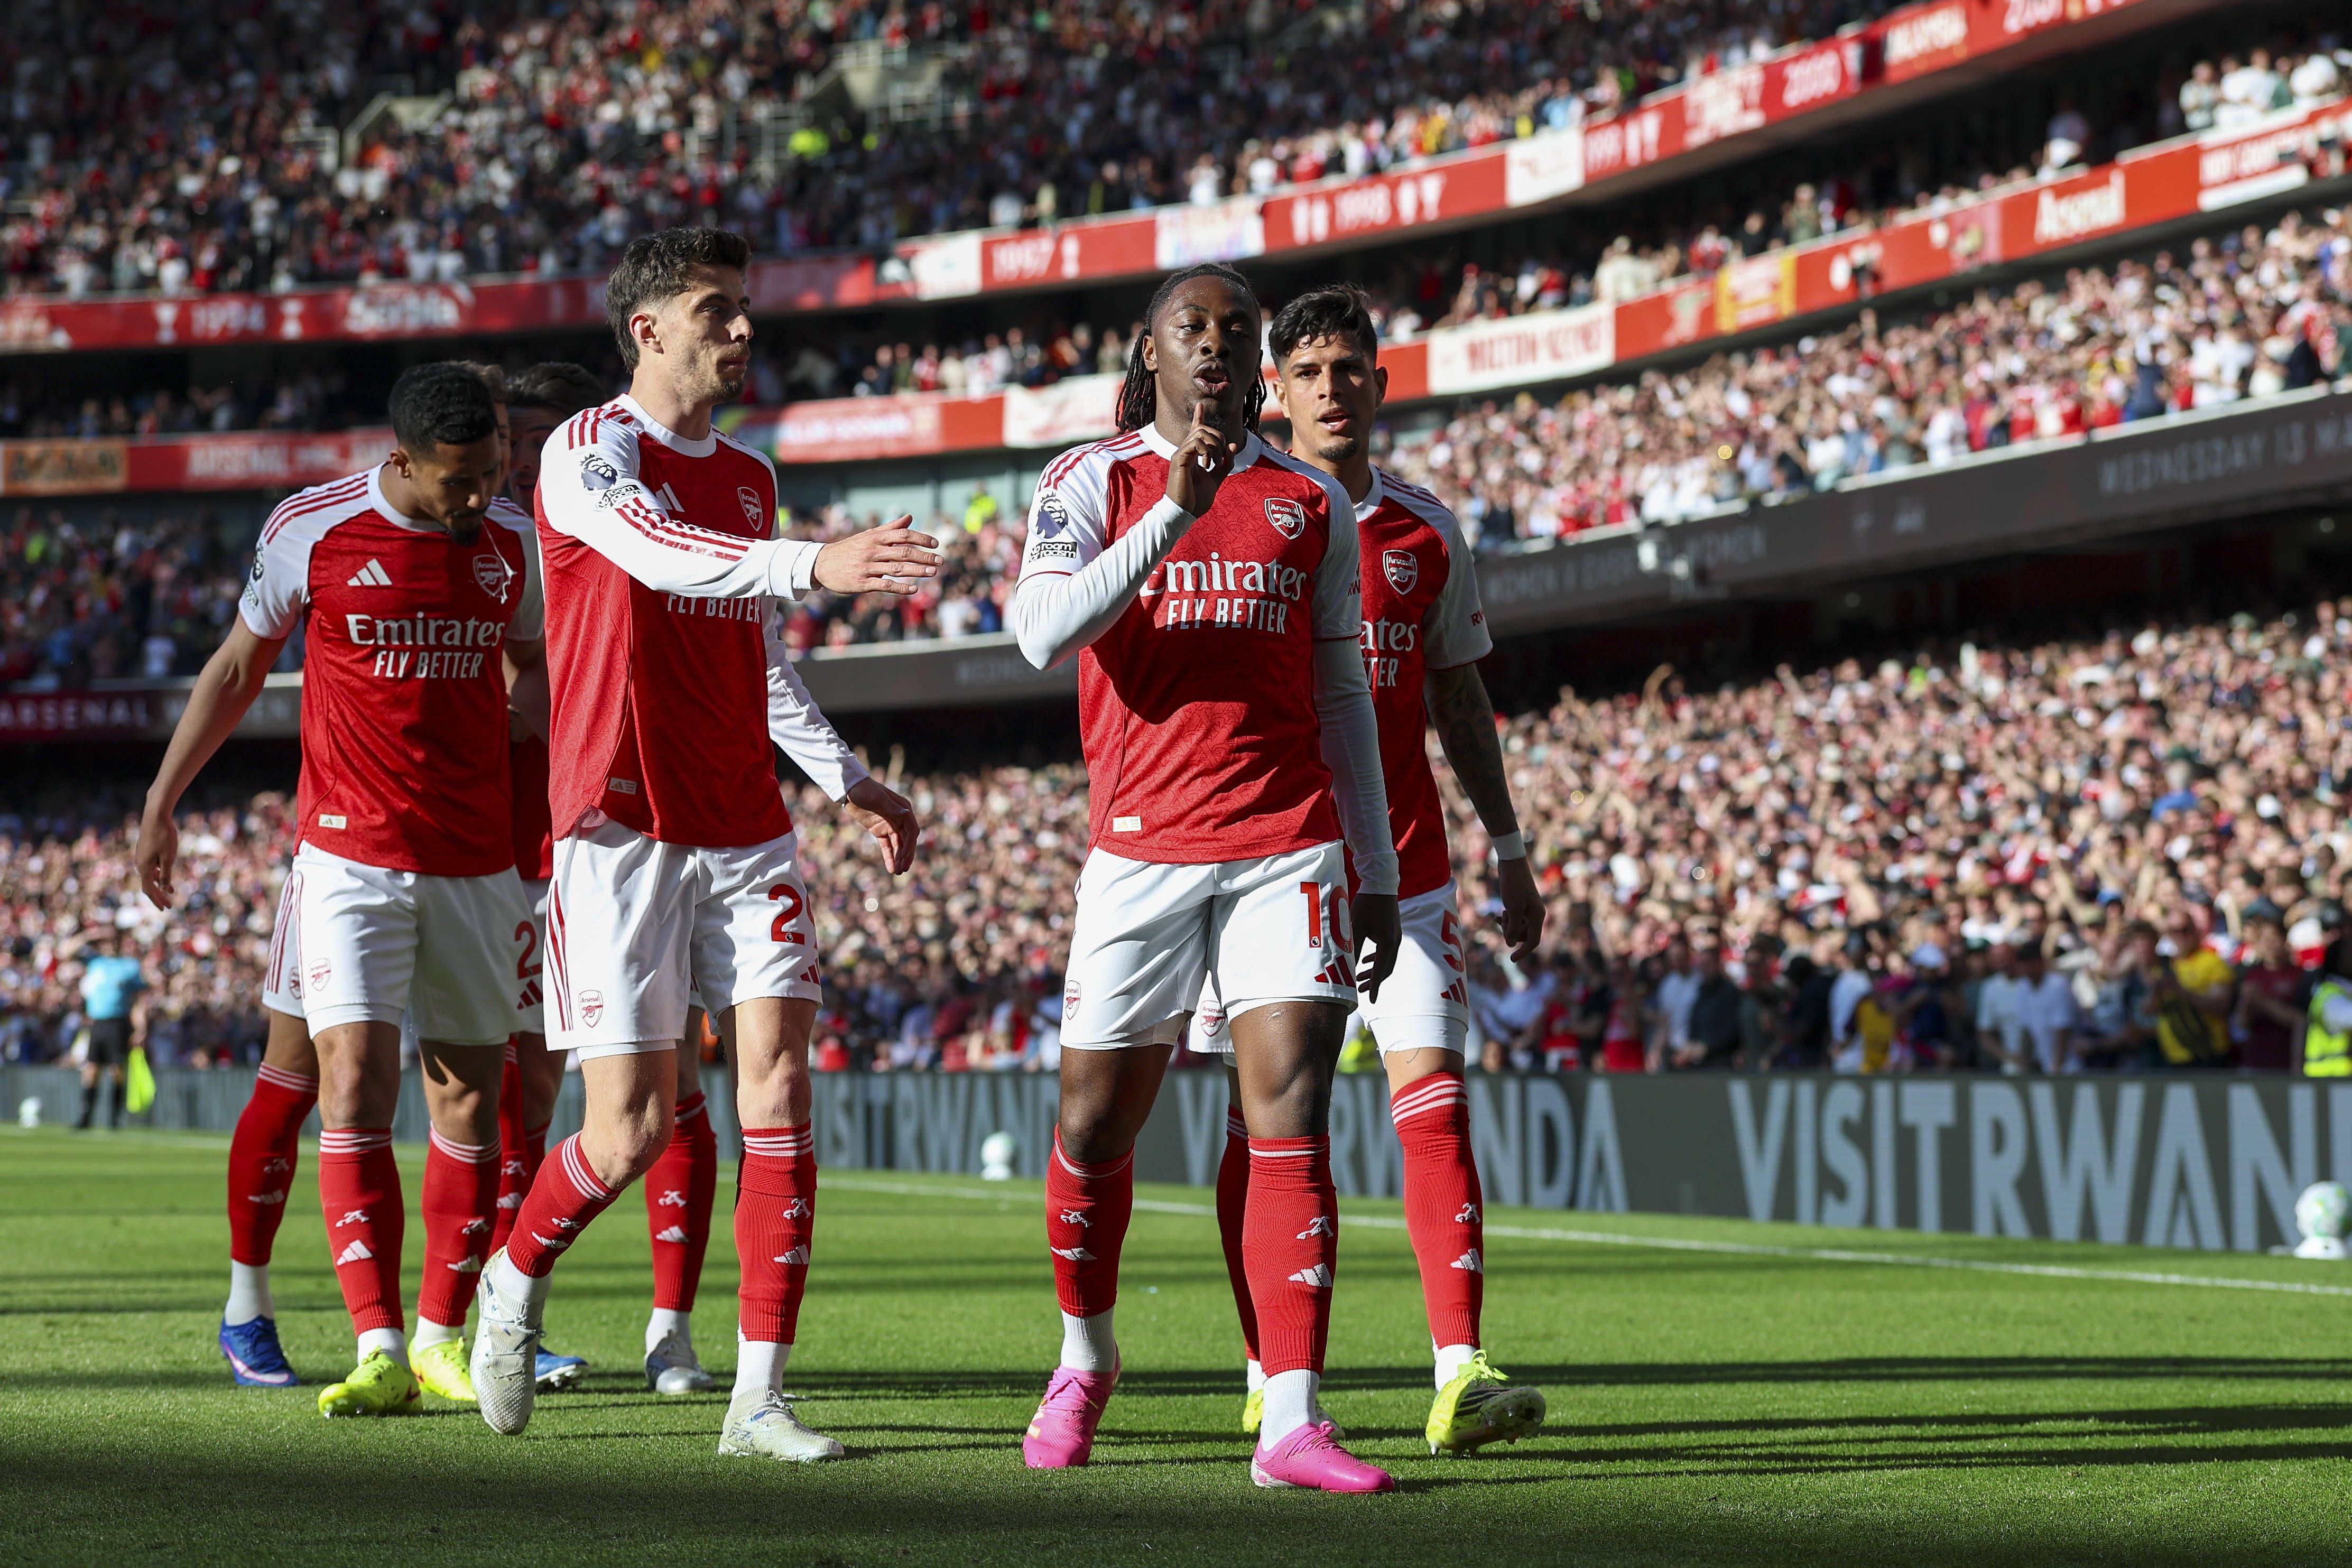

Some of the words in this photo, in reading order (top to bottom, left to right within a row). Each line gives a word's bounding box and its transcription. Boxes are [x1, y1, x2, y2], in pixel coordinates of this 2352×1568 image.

[2097, 428, 2267, 495] WEDNESDAY
[1271, 504, 1298, 515] Arsenal
[1040, 550, 1076, 559] racism
[1388, 556, 1413, 567] Arsenal
[346, 611, 505, 647] Emirates
[1166, 598, 1206, 631] FLY
[1215, 598, 1288, 634] BETTER
[1360, 616, 1418, 651] ates
[373, 650, 409, 678] FLY
[416, 652, 484, 679] BETTER
[163, 695, 291, 726] WEN
[768, 883, 818, 951] 2
[1301, 881, 1353, 954] 10
[1441, 910, 1465, 973] 5
[1329, 1075, 1631, 1213] RWNDA
